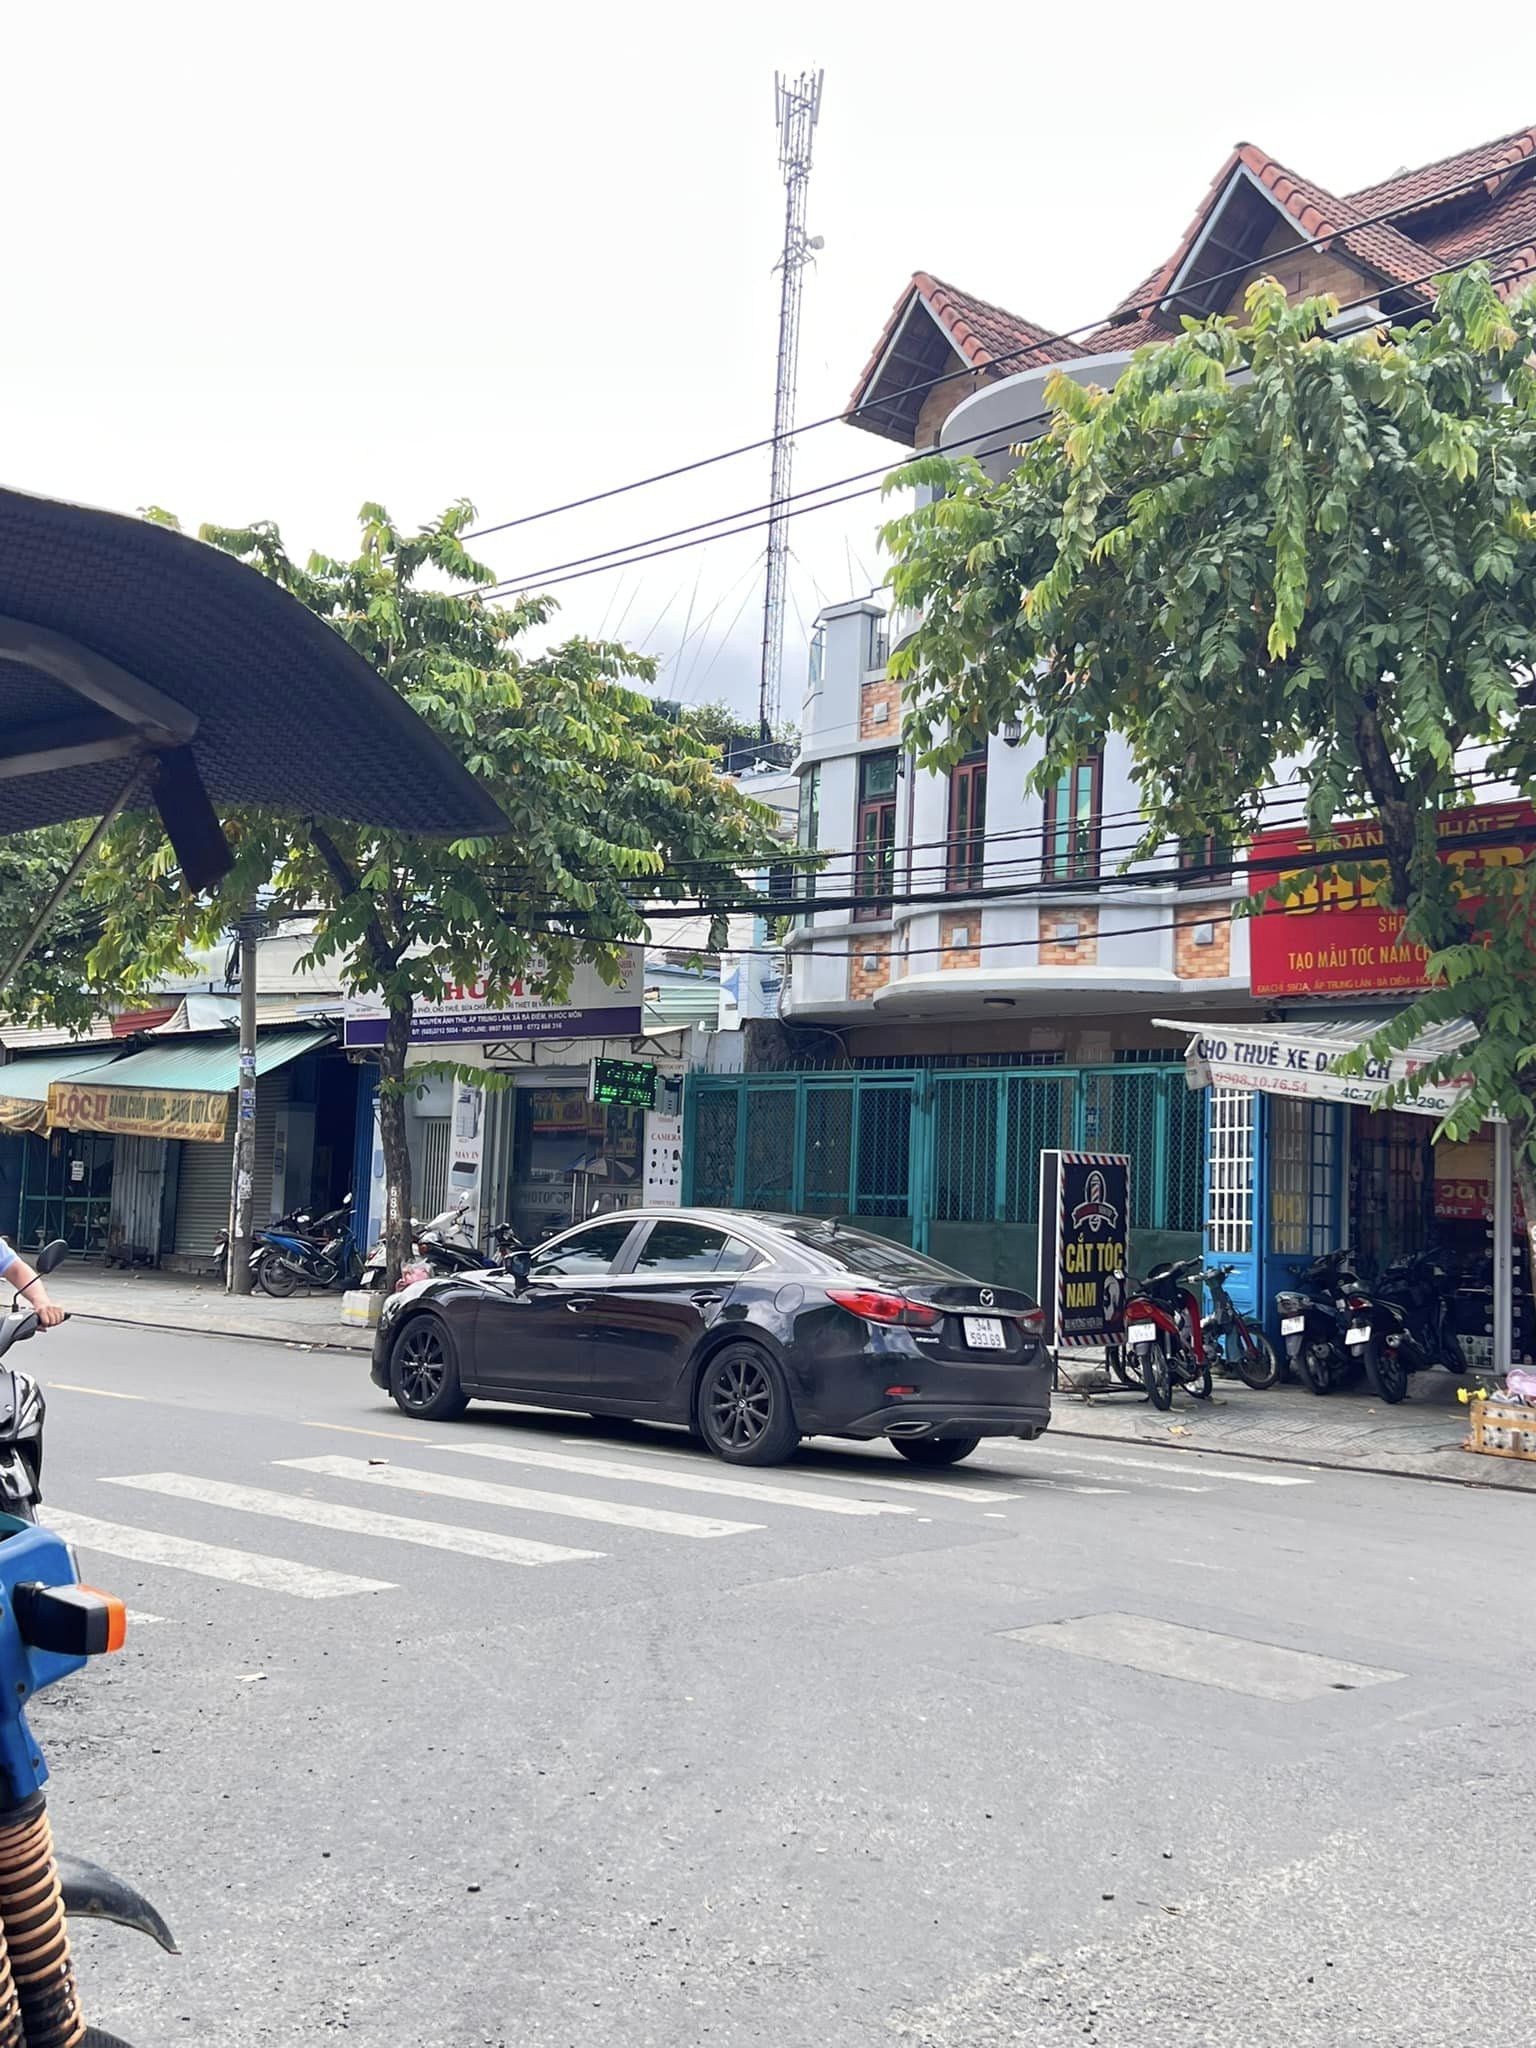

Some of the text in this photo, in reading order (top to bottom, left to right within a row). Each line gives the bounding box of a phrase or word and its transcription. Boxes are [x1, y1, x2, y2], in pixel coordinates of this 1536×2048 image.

[1288, 952, 1314, 972] TẠO
[1350, 944, 1376, 966] TÓC
[1380, 943, 1411, 963] NAM
[1197, 1039, 1227, 1061] CHO
[1233, 1041, 1279, 1066] THUÊ
[1285, 1048, 1310, 1070] XE
[650, 1131, 682, 1142] CAMERA
[1065, 1233, 1124, 1274] CẮT TÓC
[1065, 1282, 1097, 1308] NAM
